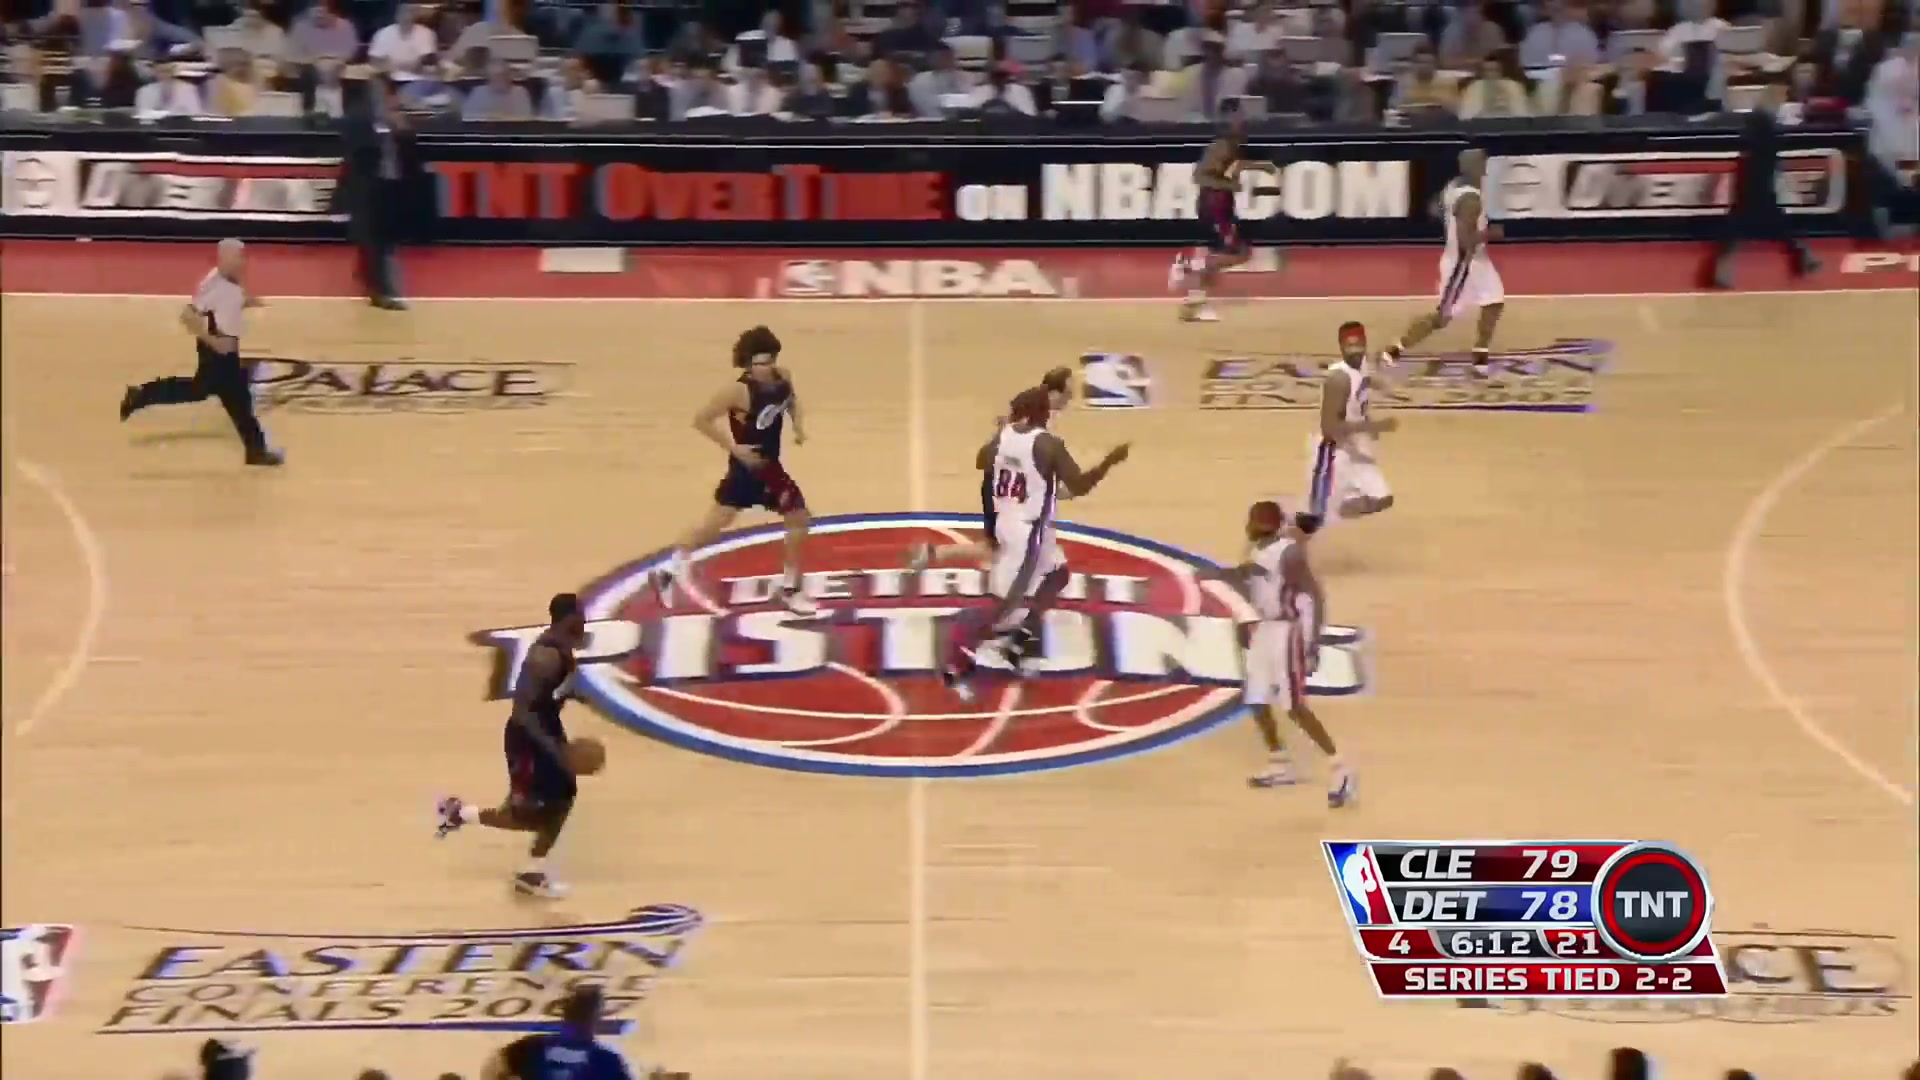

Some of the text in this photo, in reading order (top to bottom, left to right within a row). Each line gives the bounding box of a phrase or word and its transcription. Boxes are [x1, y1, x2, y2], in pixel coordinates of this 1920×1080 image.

[424, 161, 582, 218] TNT
[1041, 160, 1411, 221] NBACOM
[838, 259, 1057, 295] NBA
[721, 567, 1149, 604] DETRIT
[135, 939, 685, 980] EASTERN
[103, 1001, 406, 1026] FINALS
